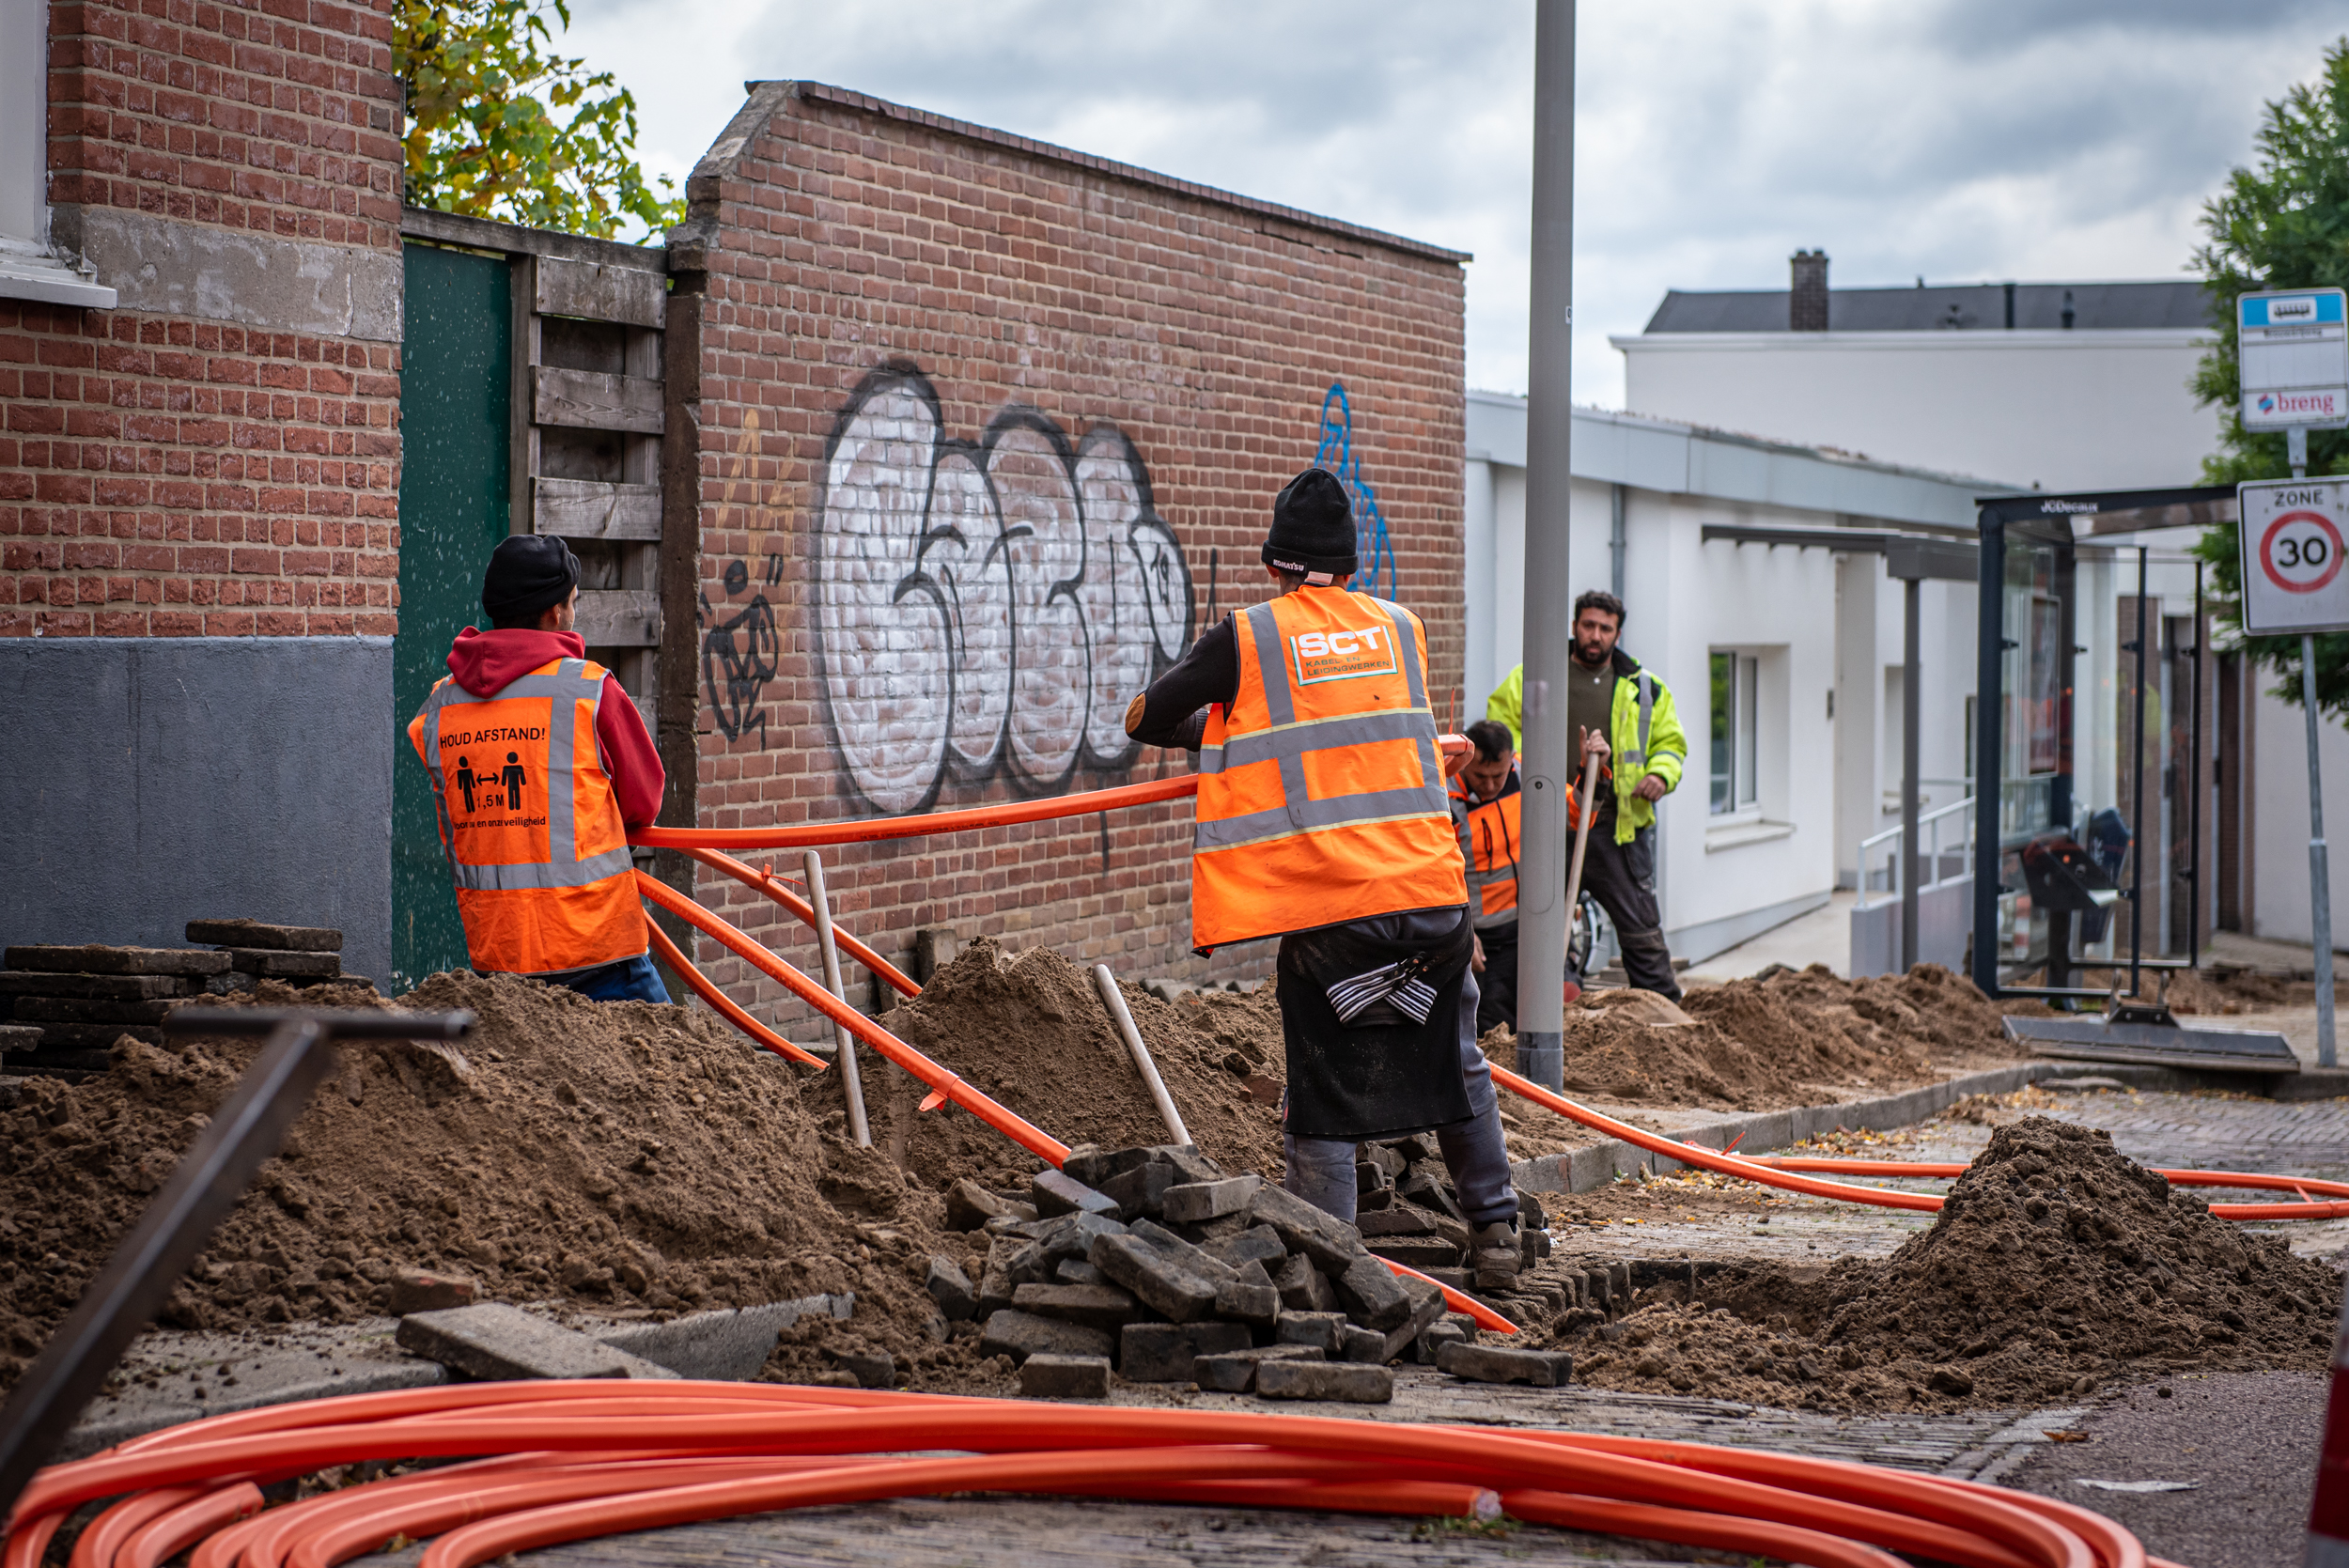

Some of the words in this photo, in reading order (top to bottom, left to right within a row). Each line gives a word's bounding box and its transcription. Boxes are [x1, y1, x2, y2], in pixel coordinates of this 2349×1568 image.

[2278, 391, 2335, 415] breng
[2041, 499, 2098, 513] JCDecaux
[2274, 489, 2324, 507] ZONE
[2278, 535, 2327, 568] 30
[1273, 559, 1304, 571] KOMATSU
[1298, 626, 1381, 658] SCT
[1306, 658, 1344, 668] KABEL-
[1307, 660, 1390, 676] LEIDINGWERKEN
[440, 732, 471, 749] HOUD
[474, 727, 545, 743] AFSTAND!
[477, 795, 493, 810] 1,5
[495, 794, 505, 806] M
[504, 816, 546, 828] veiligheid
